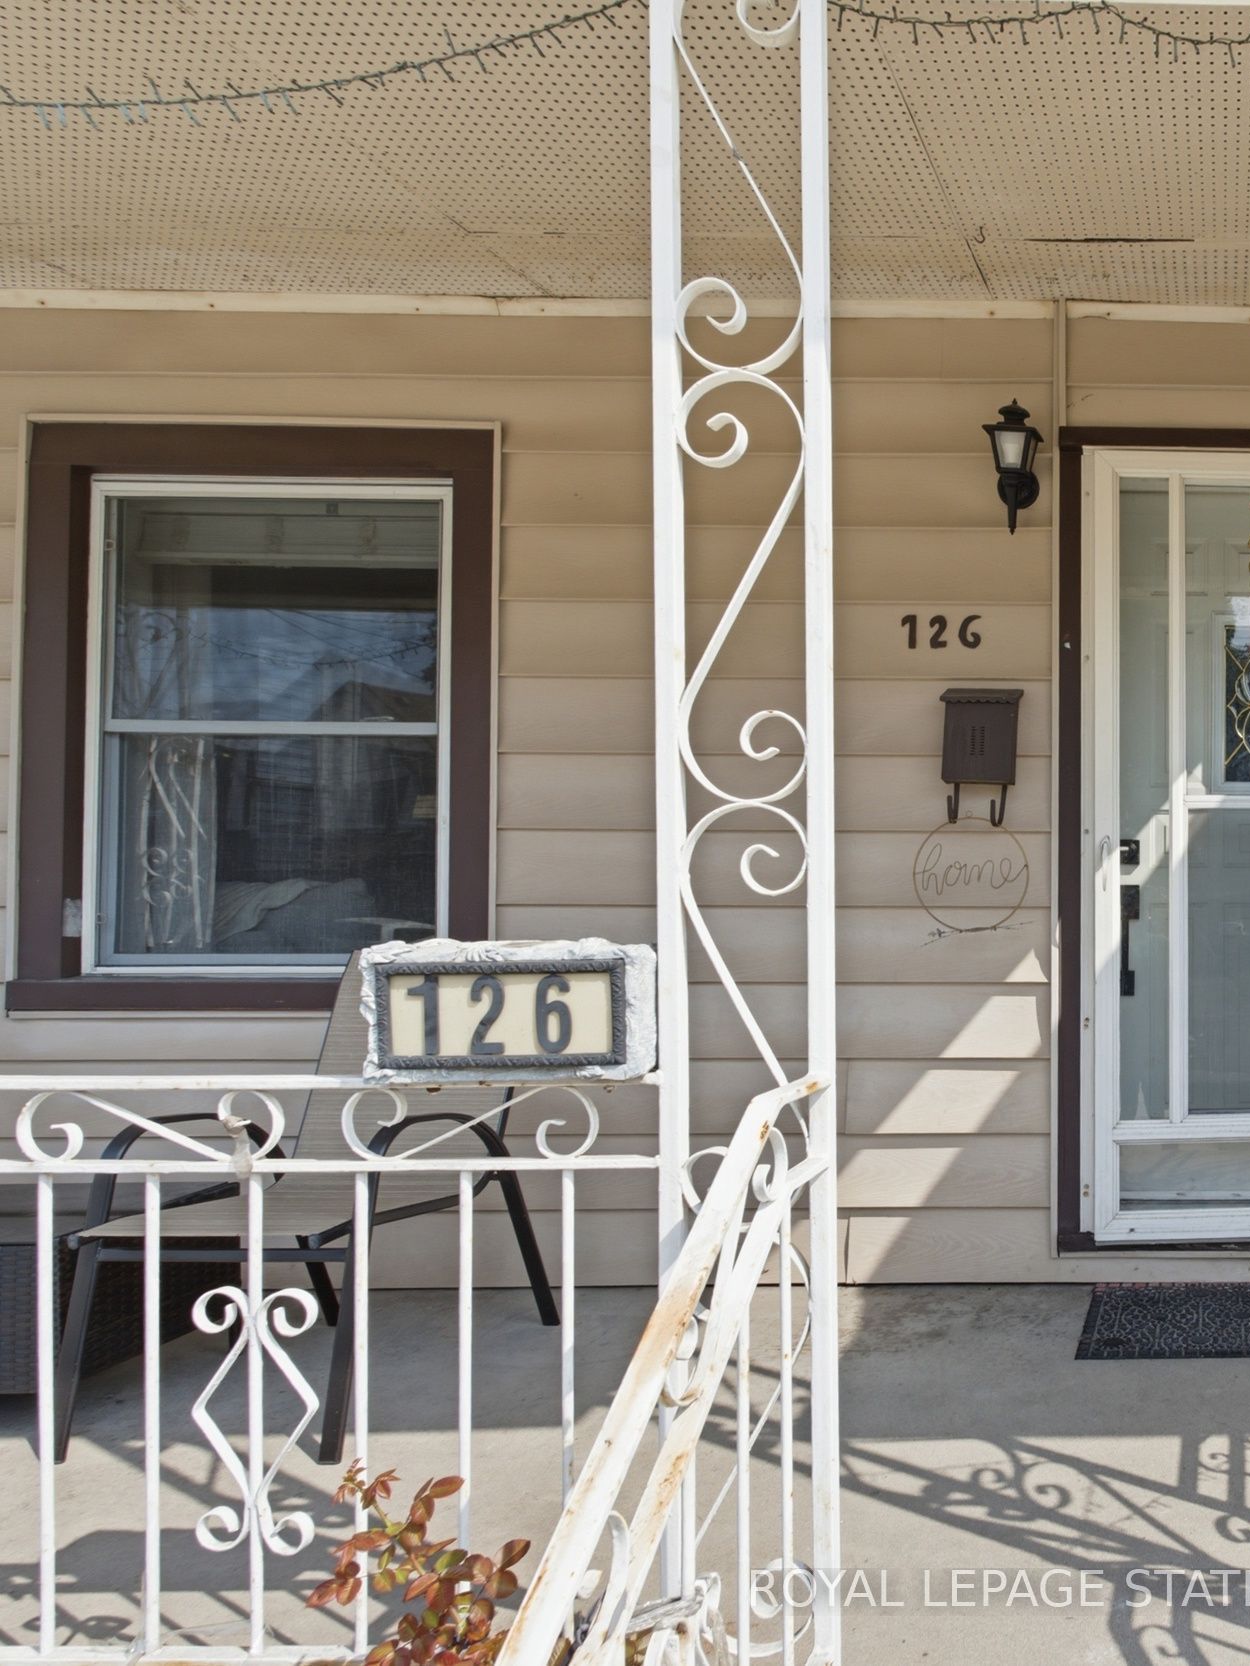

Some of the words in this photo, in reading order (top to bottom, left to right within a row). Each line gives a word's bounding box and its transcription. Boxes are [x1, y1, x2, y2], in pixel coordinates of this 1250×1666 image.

[901, 614, 982, 649] 126
[918, 842, 1028, 896] home
[406, 974, 573, 1056] 126
